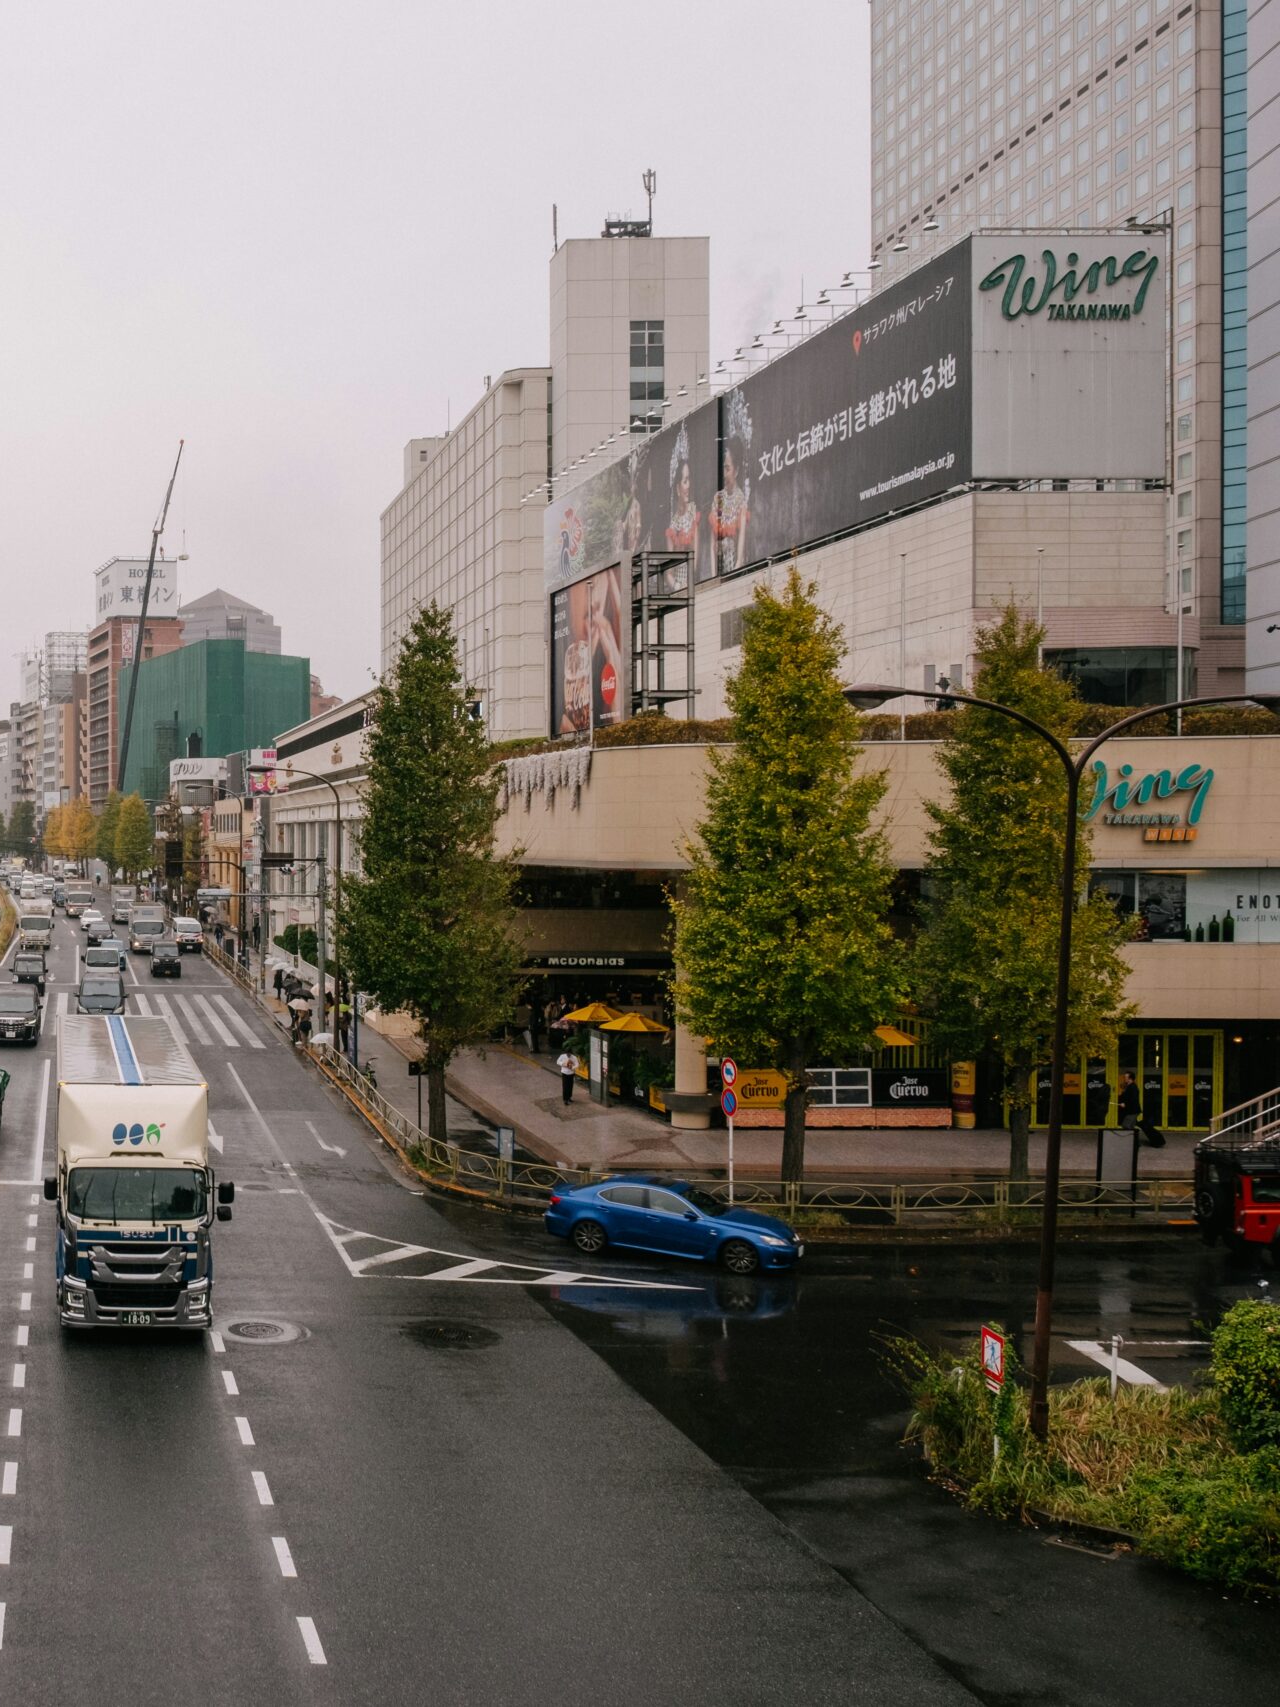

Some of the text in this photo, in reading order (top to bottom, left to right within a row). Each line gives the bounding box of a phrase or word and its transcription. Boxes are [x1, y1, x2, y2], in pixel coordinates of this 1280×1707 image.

[978, 249, 1160, 321] Wing
[863, 276, 955, 345] サラワク州/マレーシア
[1047, 304, 1131, 321] TAKANAWA
[758, 353, 957, 481] 文化と伝統が引き継がれる地
[859, 451, 956, 501] www.tourismmalaysia.or.jp
[1105, 813, 1182, 825] TAKANAWA
[1145, 828, 1198, 841] WEST
[741, 1084, 779, 1099] Cuervo
[889, 1082, 929, 1099] Cuervo
[120, 1231, 155, 1239] ISUZU
